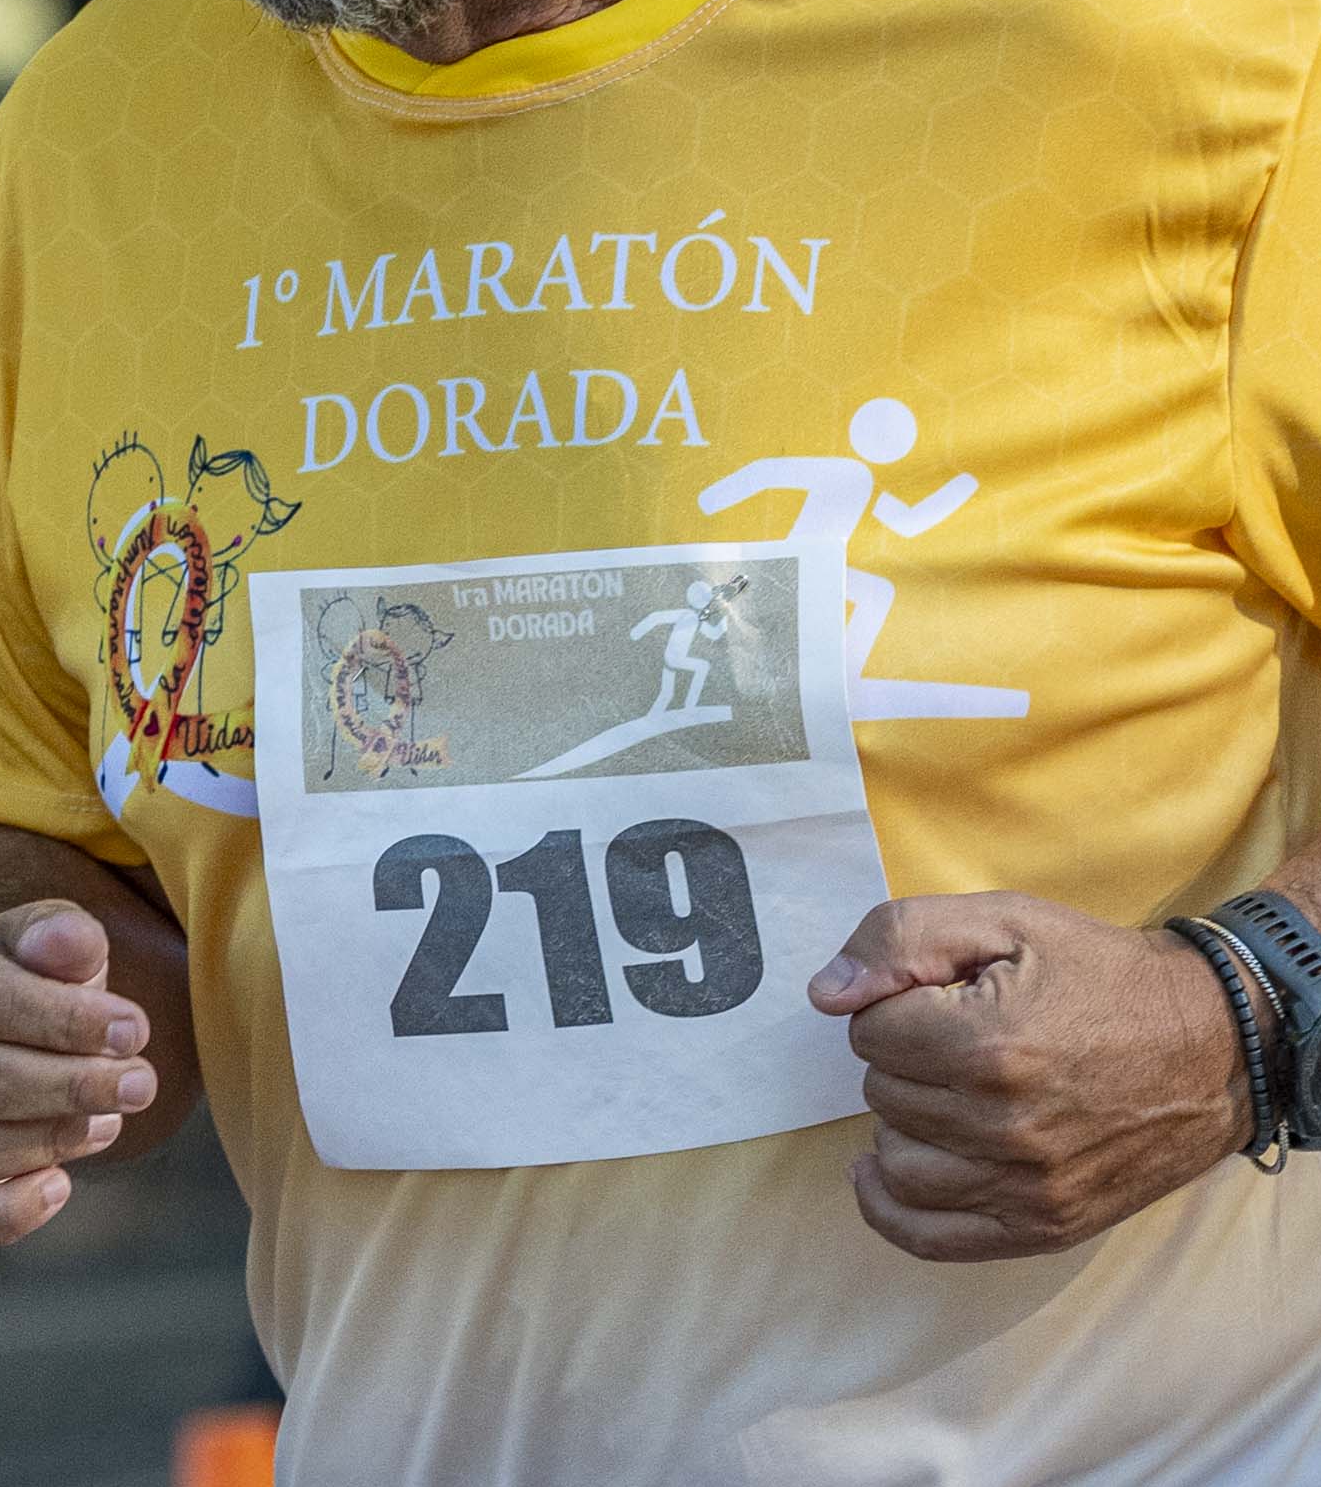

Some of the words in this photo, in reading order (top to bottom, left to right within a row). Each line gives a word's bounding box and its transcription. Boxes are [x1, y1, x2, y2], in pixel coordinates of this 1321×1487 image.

[318, 209, 830, 338] MARATÓN
[296, 368, 710, 474] DORADA
[488, 609, 595, 642] DORADA
[493, 570, 624, 606] MARATON
[373, 819, 764, 1037] 219
